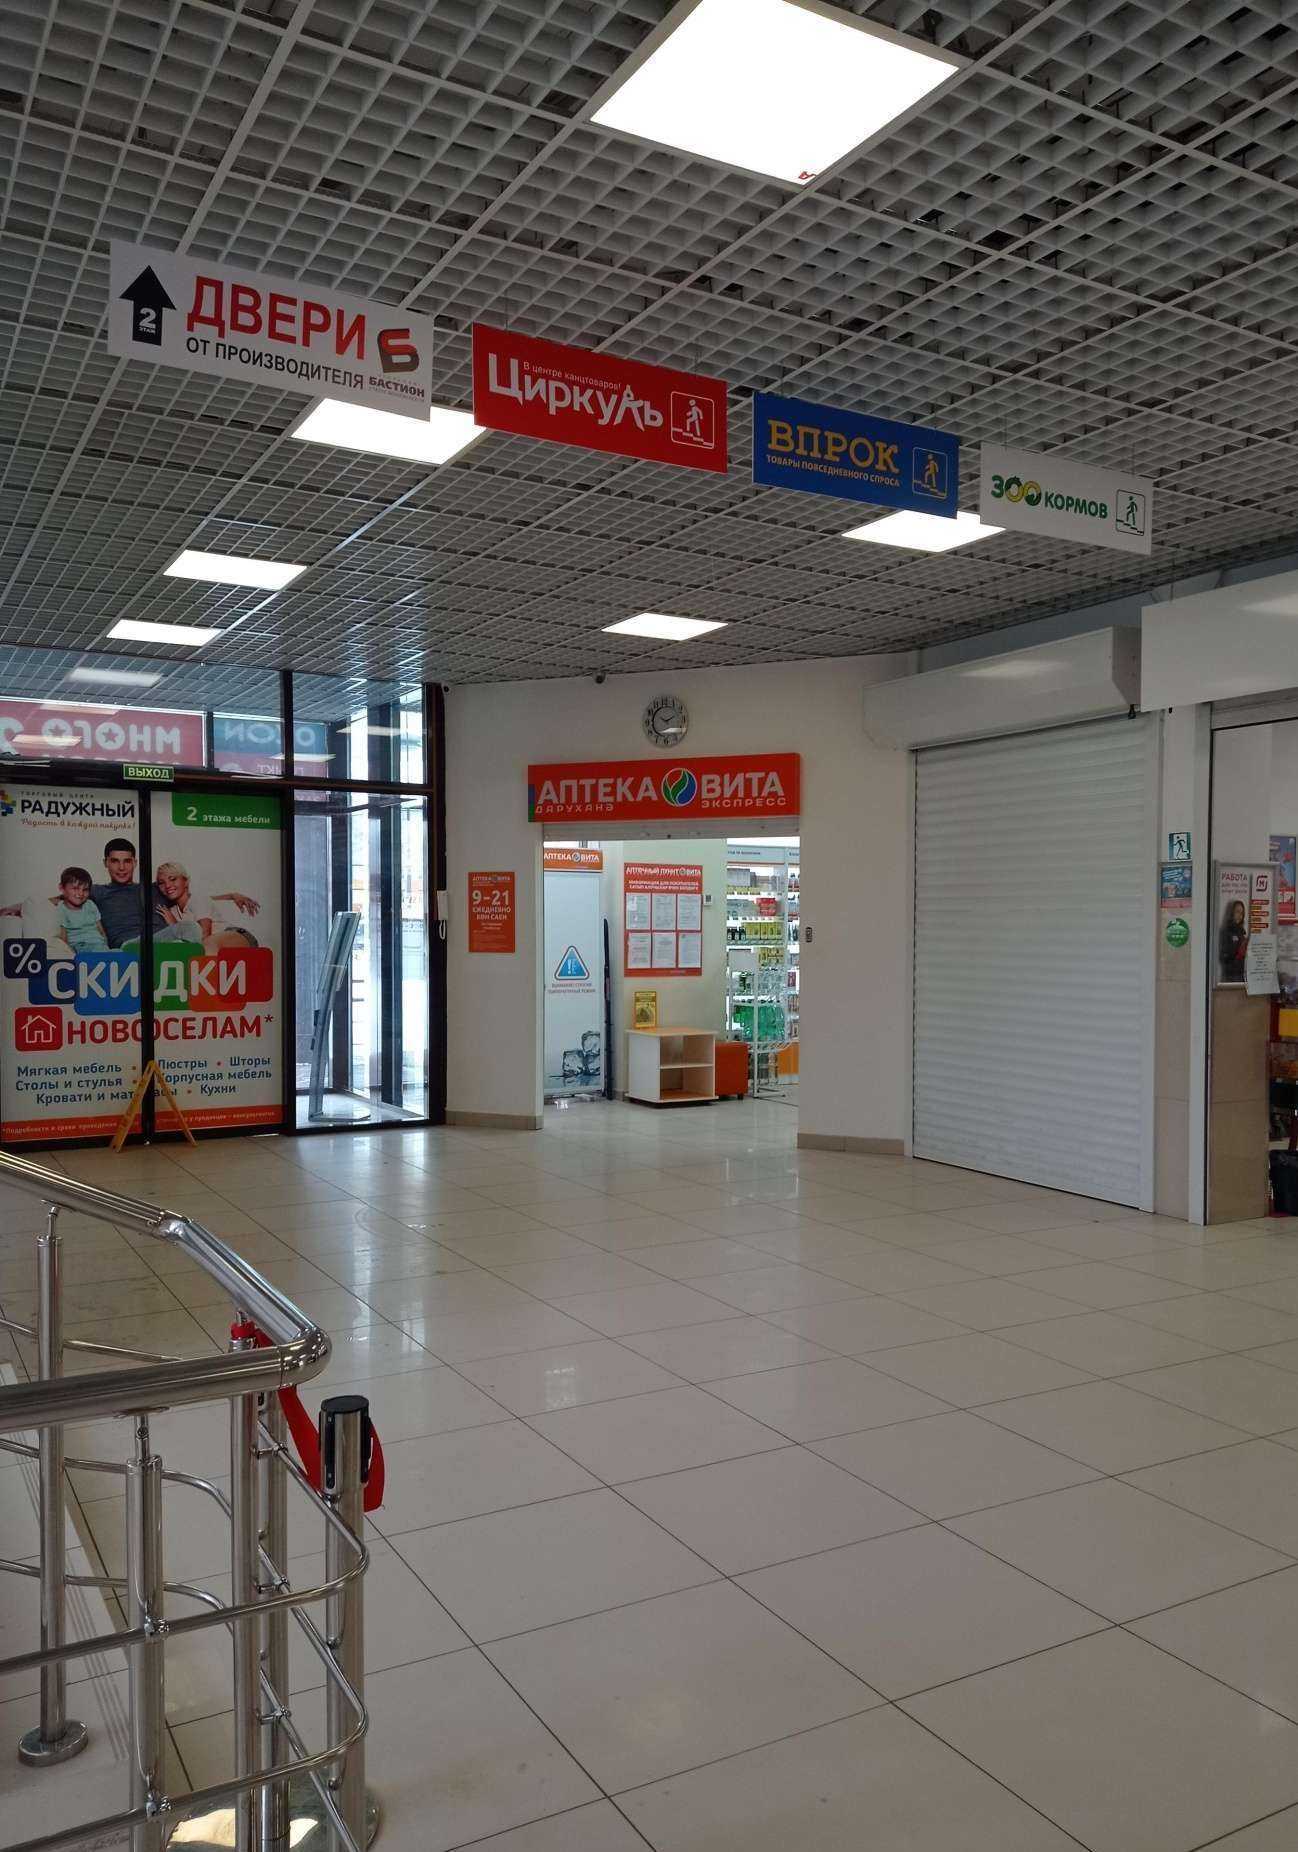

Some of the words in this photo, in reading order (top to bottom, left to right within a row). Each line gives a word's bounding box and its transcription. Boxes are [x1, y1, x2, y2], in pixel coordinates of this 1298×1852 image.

[139, 307, 156, 329] 2
[187, 275, 366, 360] ДВЕРИ
[186, 337, 210, 355] ОТ
[215, 342, 364, 390] ПРОИЗВОДИТЕЛЯ
[532, 365, 562, 377] центре
[369, 375, 425, 398] БАСТИОН
[488, 352, 664, 432] Циркуль
[767, 419, 900, 474] ВПРОК
[766, 454, 801, 468] ТОВАРЫ
[801, 460, 869, 481] ПОВСЕДНЕВНОГО
[869, 474, 900, 487] СПРОСА
[1044, 490, 1109, 519] КОРМОВ
[128, 766, 171, 780] ВЫХОД
[537, 776, 659, 804] АПТЕКА
[701, 770, 786, 799] ВИТА
[20, 799, 135, 818] РАДУЖНЫЙ
[186, 806, 197, 821] 2
[203, 814, 232, 823] этажа
[234, 814, 270, 824] мебели
[701, 797, 787, 809] ЭКСПРЕСС
[47, 959, 247, 1003] СКИДКИ
[17, 1065, 68, 1077] Мягкая
[73, 1062, 122, 1074] мебель
[229, 1056, 272, 1068] Шторы
[15, 1080, 59, 1092] Столы
[64, 1081, 72, 1089] и
[77, 1078, 123, 1090] стулья
[158, 1070, 223, 1085] орпусная
[227, 1068, 272, 1080] мебель
[36, 1093, 92, 1107] Кровати
[97, 1091, 105, 1101] и
[200, 1083, 236, 1096] Кухни
